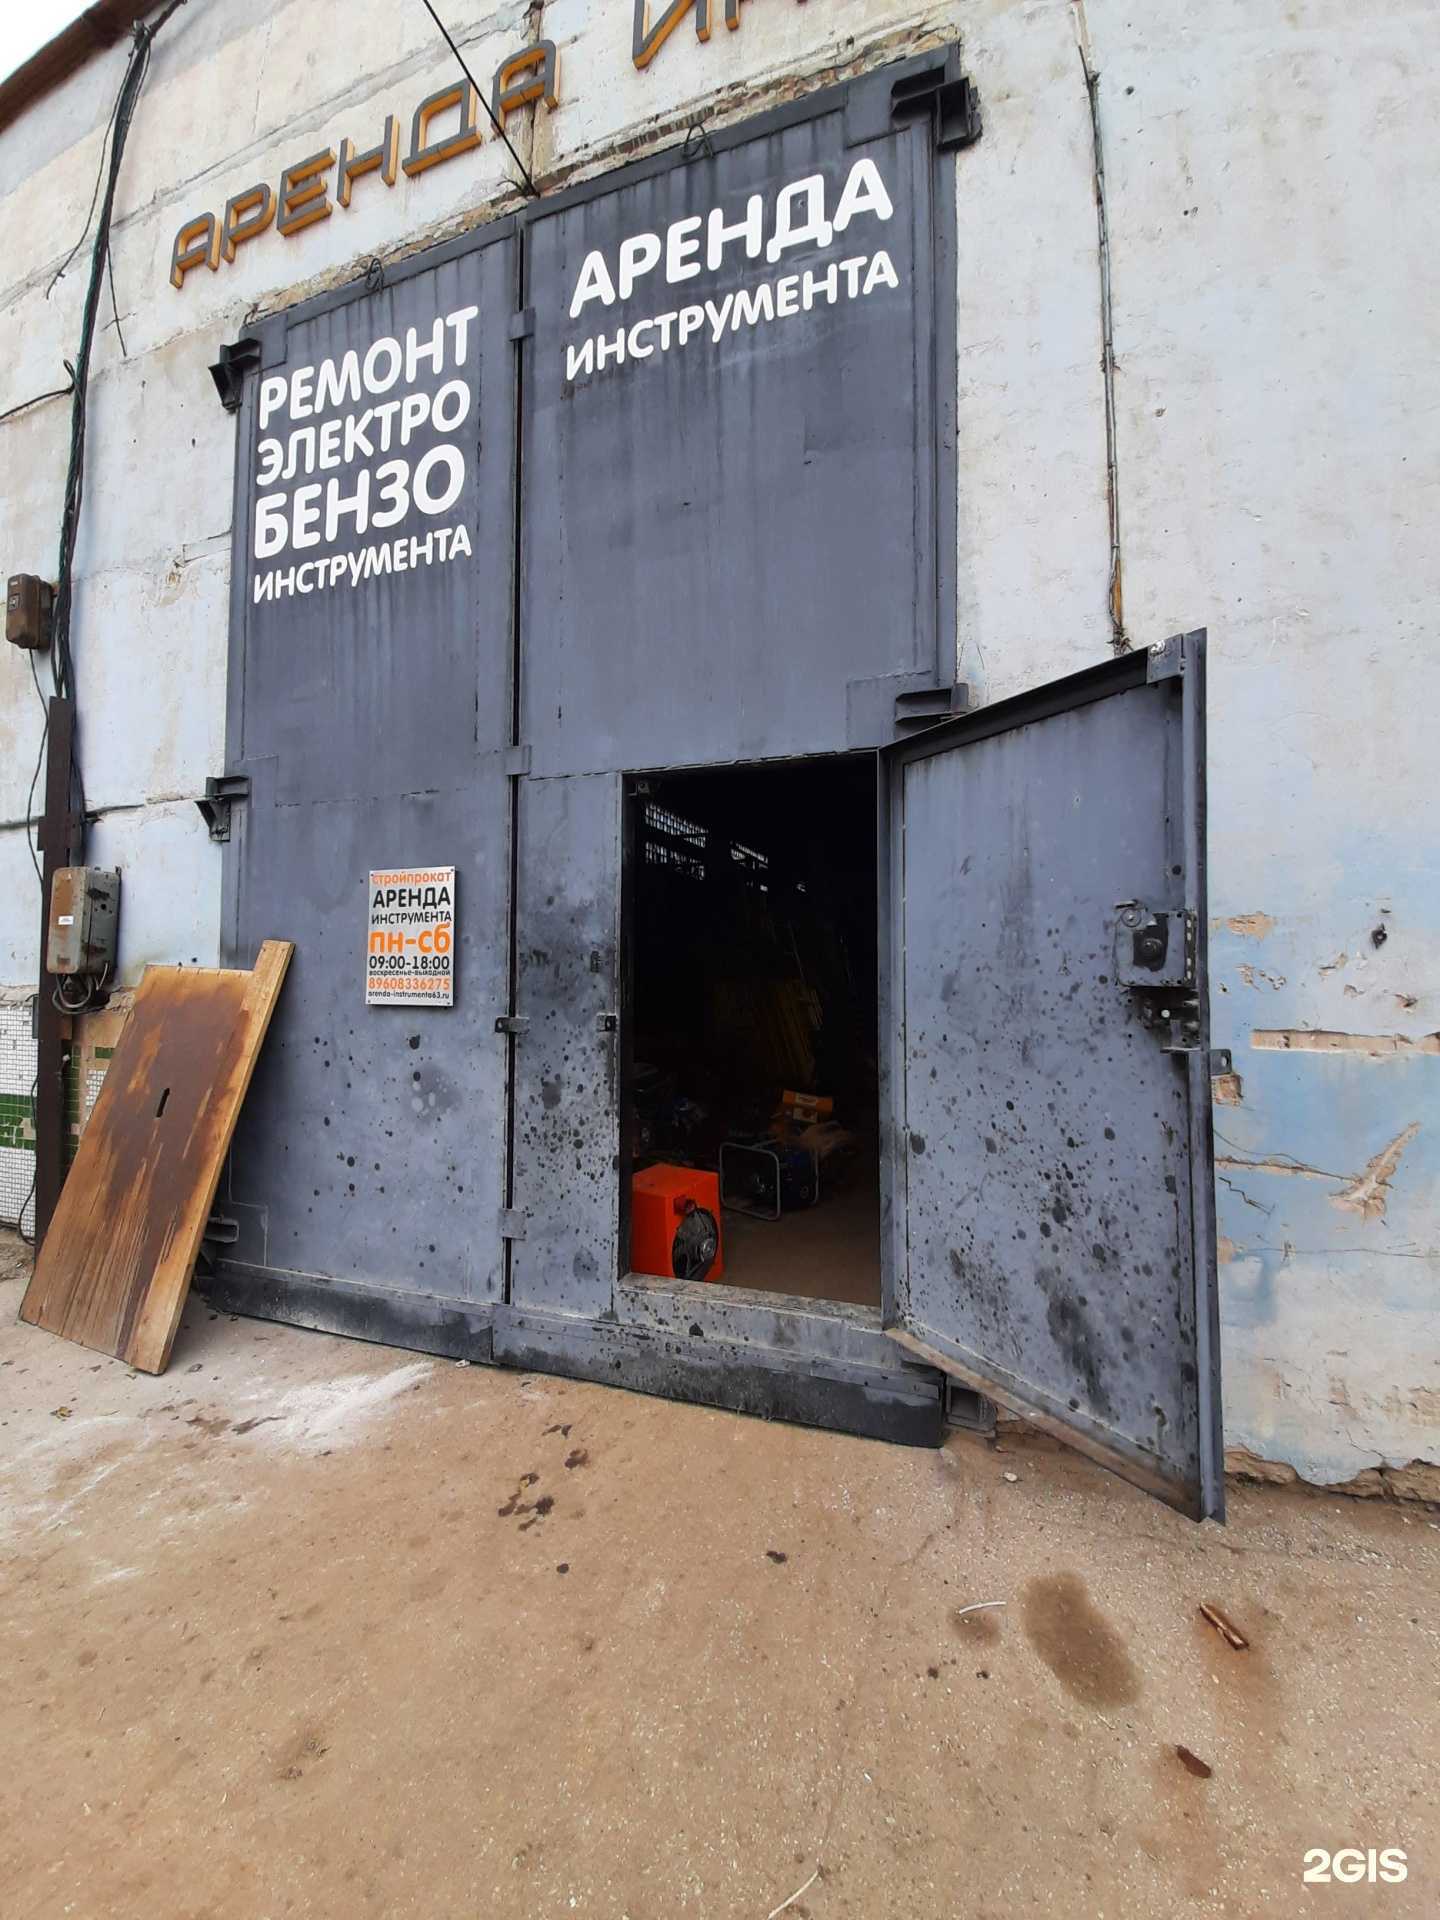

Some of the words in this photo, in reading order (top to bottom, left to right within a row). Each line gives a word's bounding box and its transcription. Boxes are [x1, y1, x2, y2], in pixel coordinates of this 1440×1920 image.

[169, 40, 560, 289] АРЕНДА
[569, 158, 893, 318] АРЕНДА
[259, 305, 478, 430] РЕМОНТ
[566, 250, 899, 380] ИНСТРУМЕНТА
[256, 379, 471, 486] ЭЛЕКТРО
[254, 443, 465, 559] БЕНЗО
[253, 524, 472, 604] ИНСТРУМЕНТА
[371, 910, 452, 925] ИНСТРУМЕНТА
[373, 886, 451, 909] АРЕНДА
[369, 955, 450, 970] 09:00-18:00
